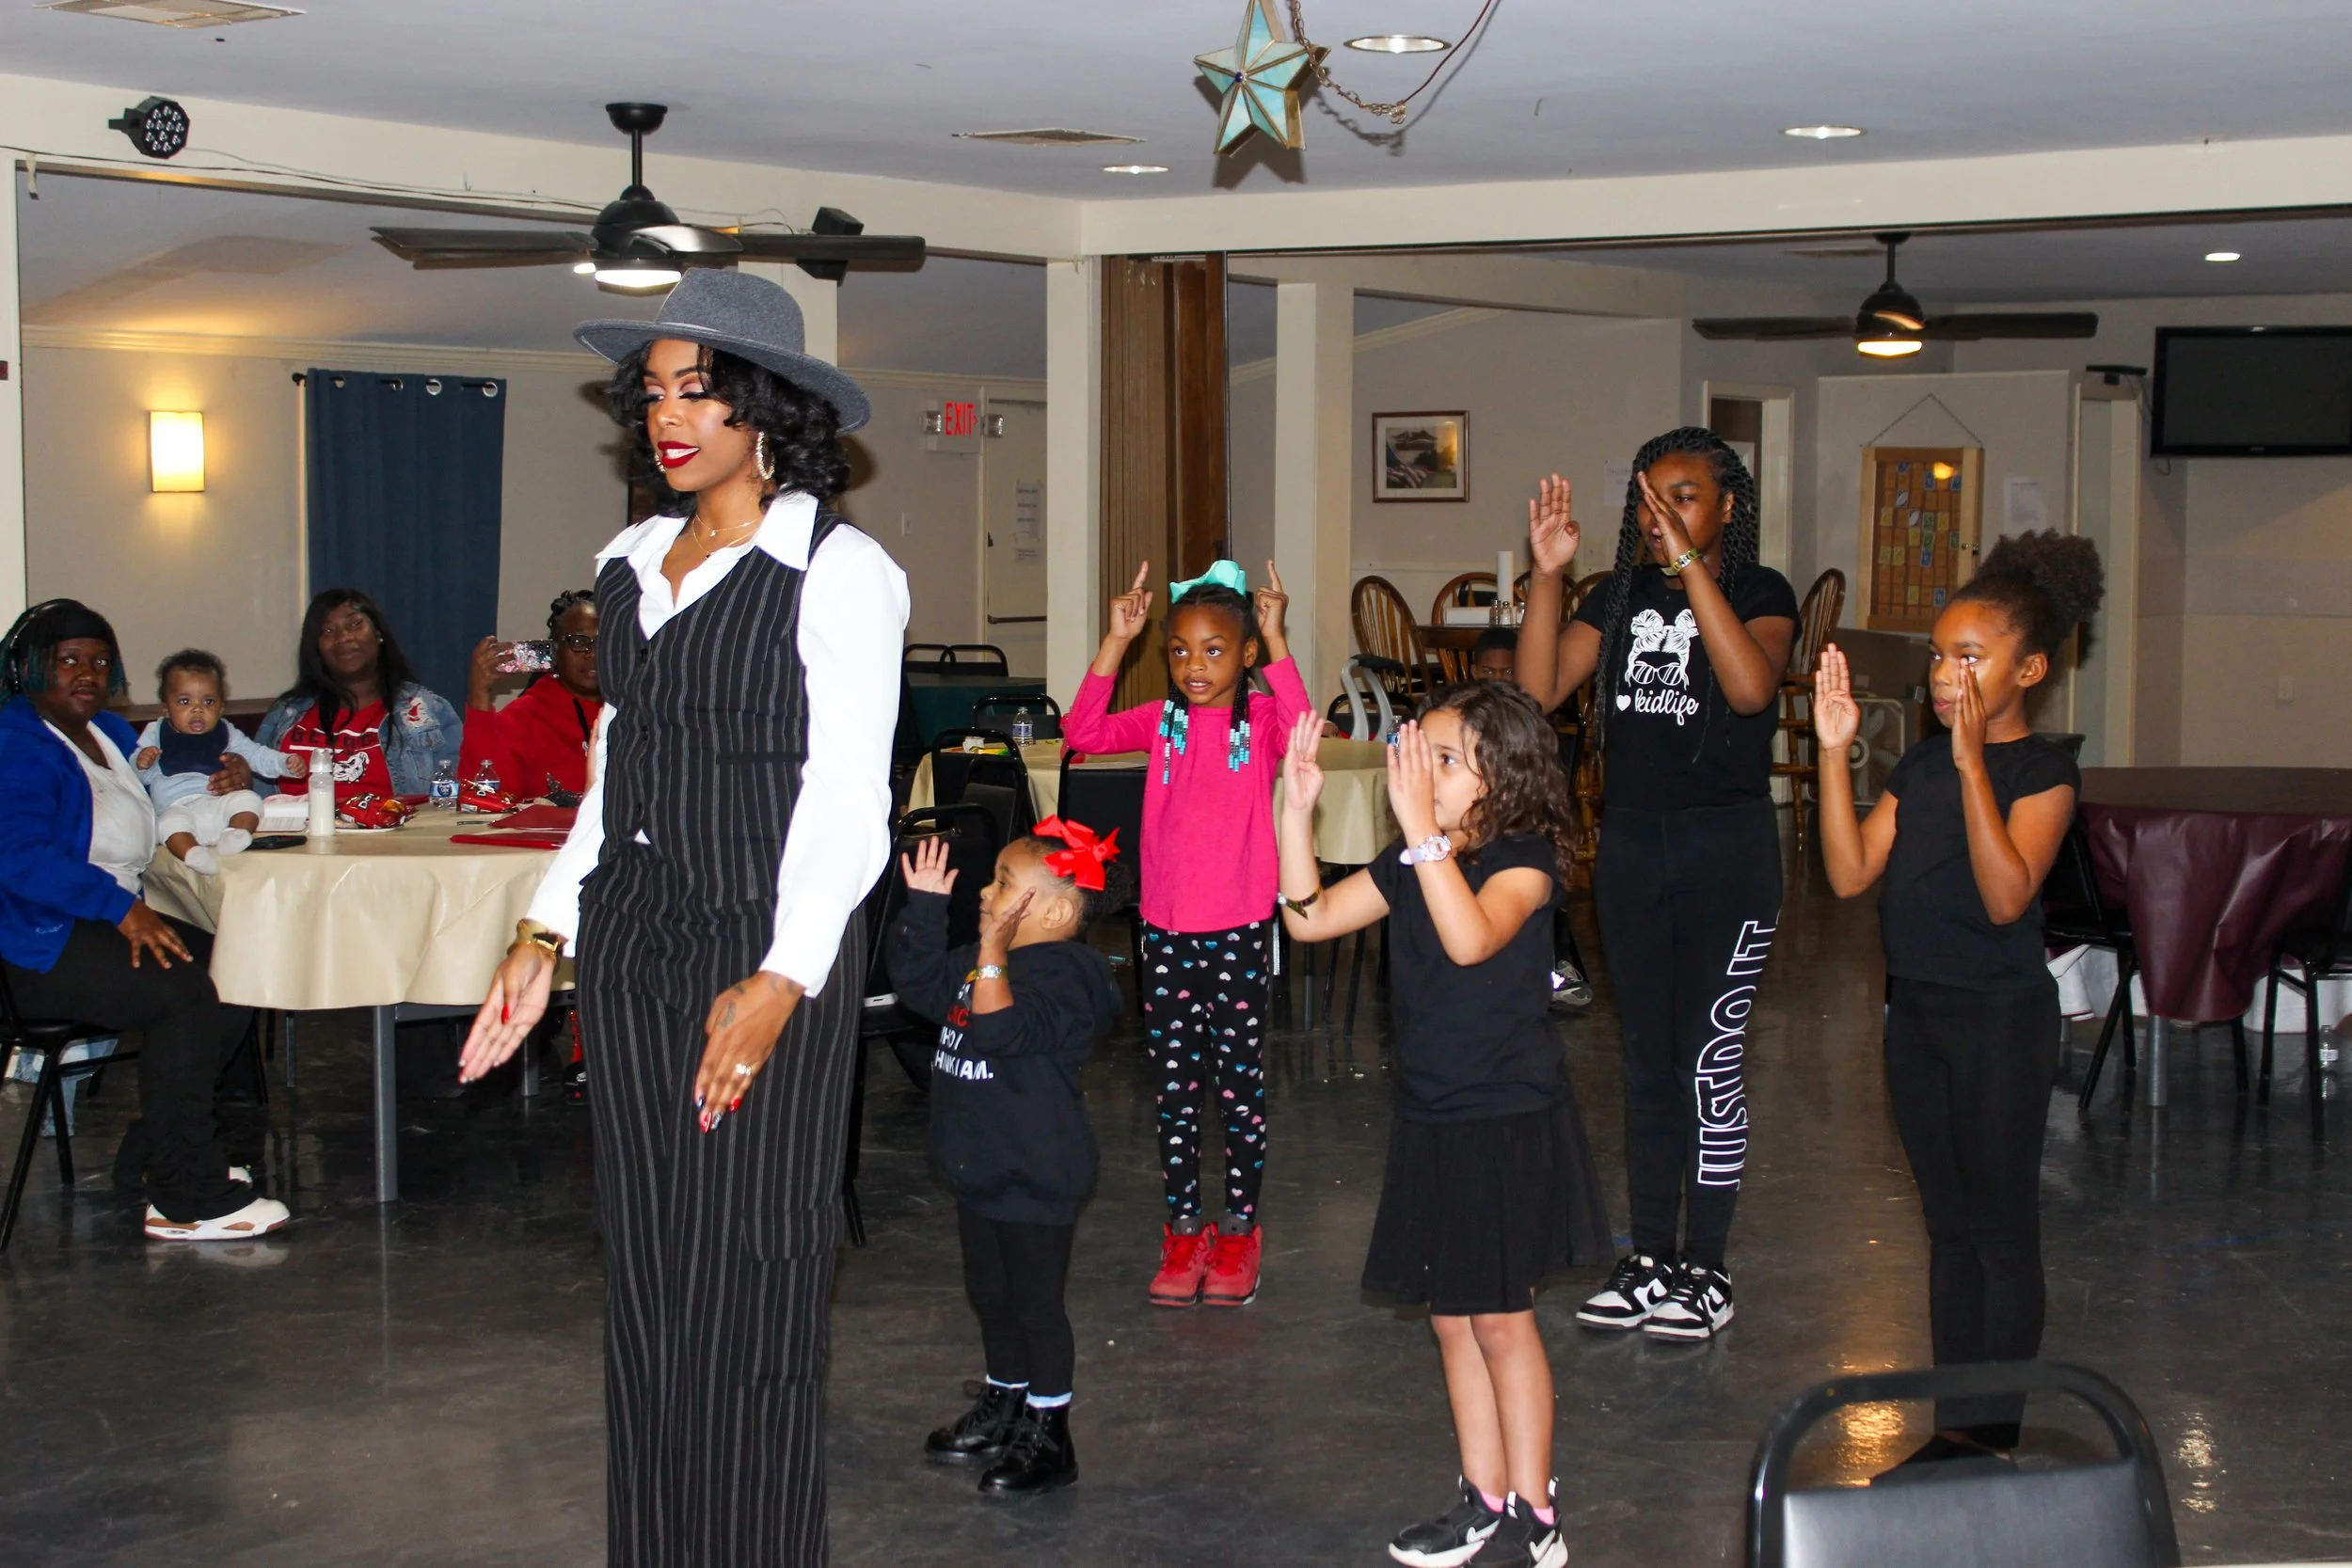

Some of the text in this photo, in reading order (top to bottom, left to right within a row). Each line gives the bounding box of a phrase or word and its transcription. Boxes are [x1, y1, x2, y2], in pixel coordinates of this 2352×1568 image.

[945, 402, 975, 436] EXIT
[1634, 688, 1700, 726] kidlife
[1694, 920, 1776, 1191] JUST DO IT
